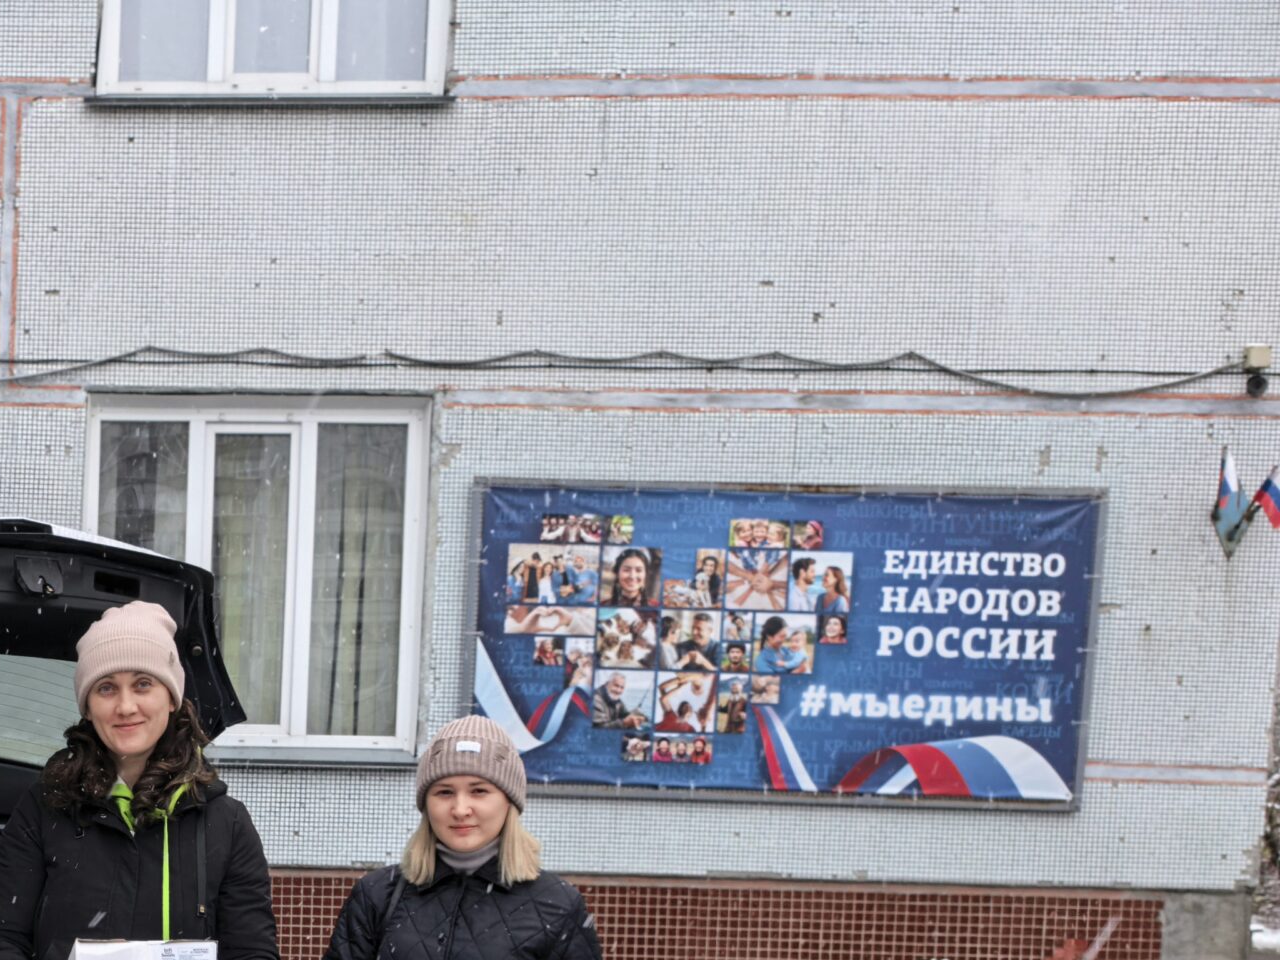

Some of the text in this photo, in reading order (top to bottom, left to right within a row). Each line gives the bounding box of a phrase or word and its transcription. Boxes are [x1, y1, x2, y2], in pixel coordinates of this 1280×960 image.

[882, 550, 1066, 580] ЕДИНСТВО
[879, 586, 1062, 622] НАРОДОВ
[876, 626, 1058, 661] РОССИИ
[800, 684, 1054, 726] #мыедины
